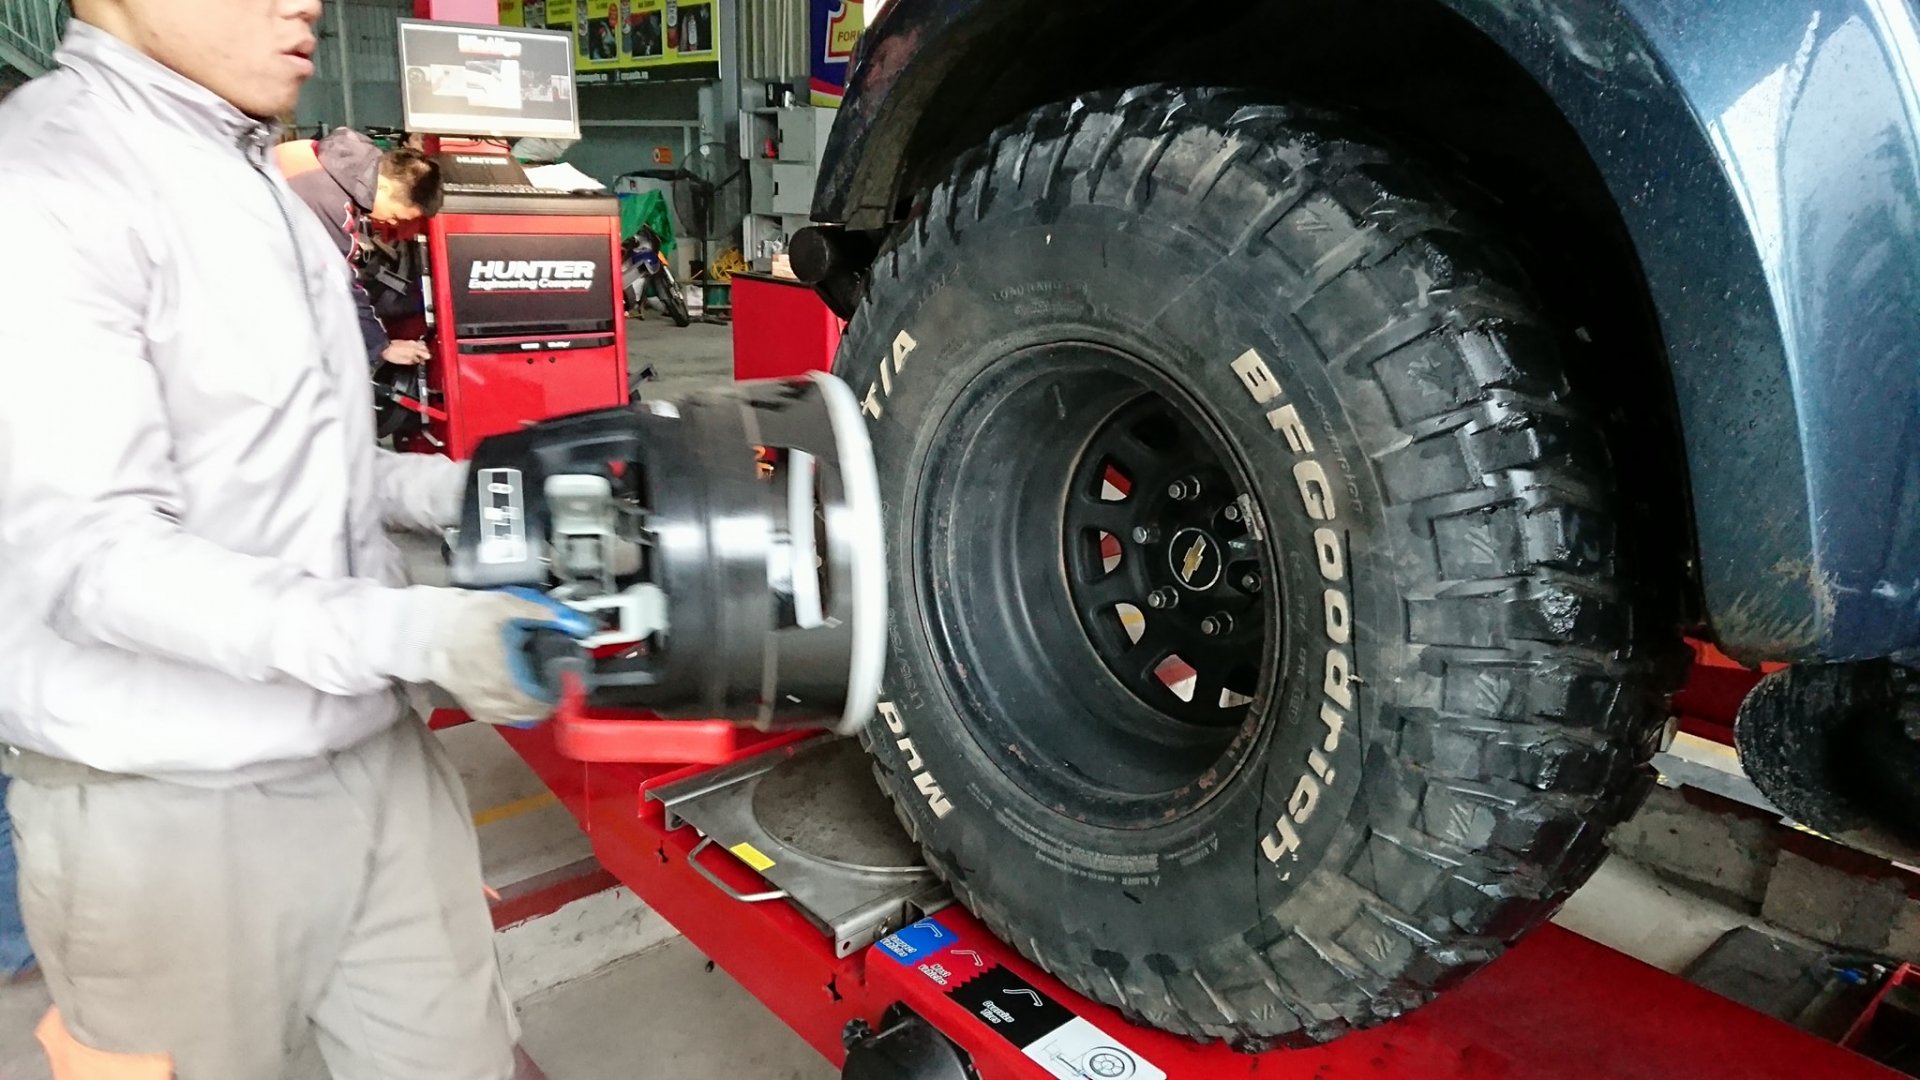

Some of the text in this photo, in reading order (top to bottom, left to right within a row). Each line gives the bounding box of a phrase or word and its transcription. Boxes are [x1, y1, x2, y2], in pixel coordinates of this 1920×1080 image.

[470, 260, 597, 279] HUNTER
[468, 278, 593, 291] Engineering Company
[861, 329, 918, 421] T/A
[1231, 347, 1353, 864] BFGoodrich
[918, 963, 948, 986] Vehicles
[930, 963, 952, 978] Most
[980, 1008, 1002, 1024] Tires
